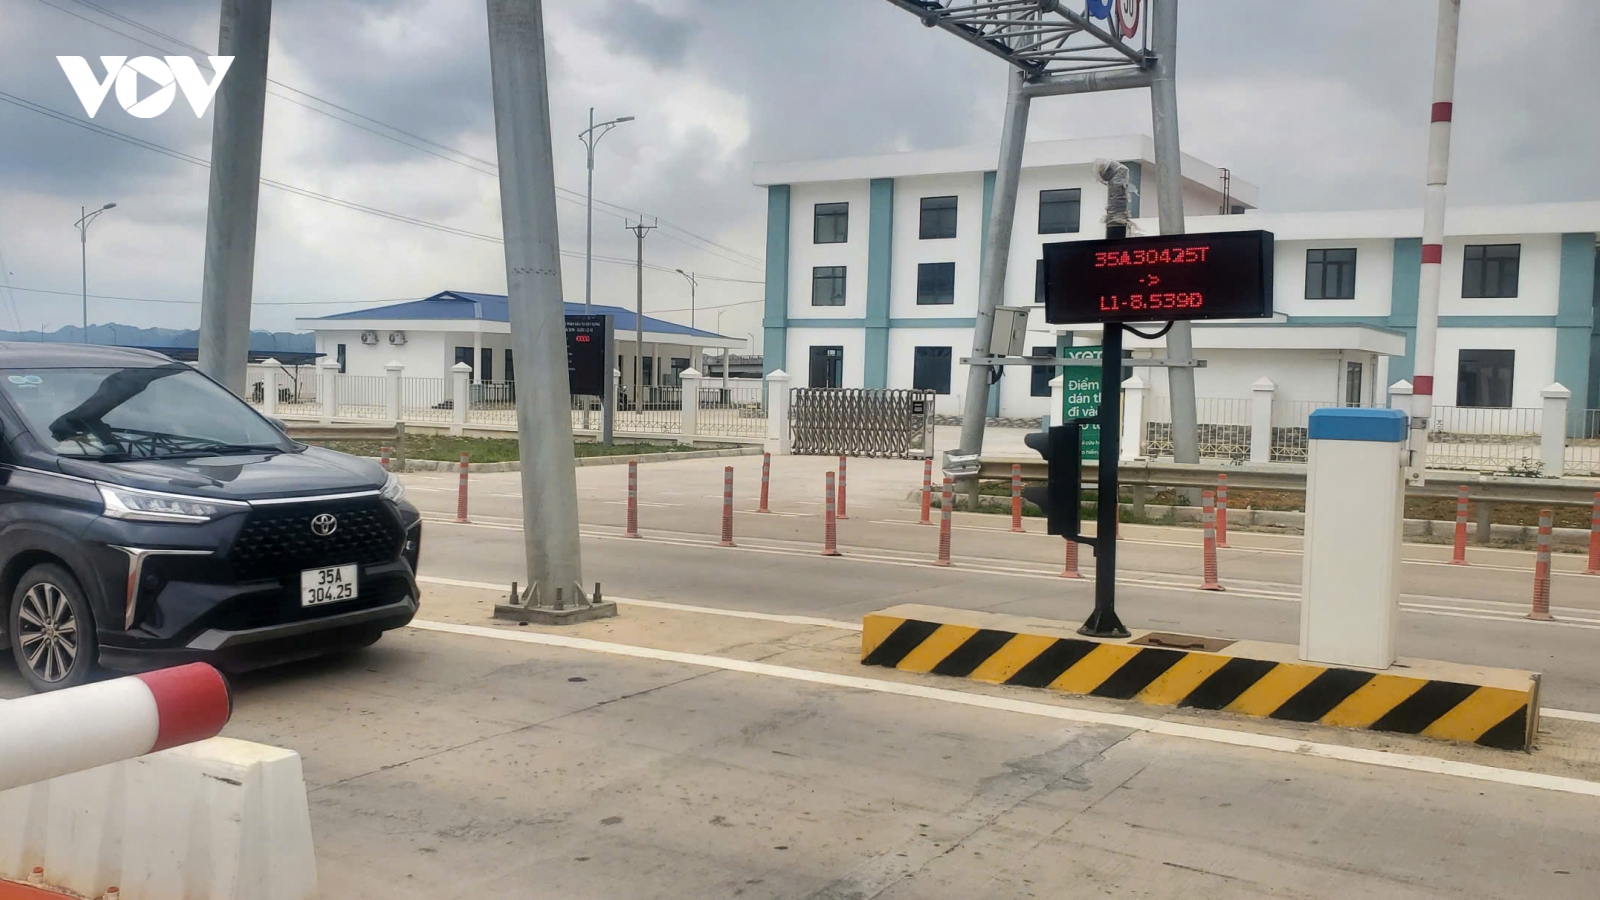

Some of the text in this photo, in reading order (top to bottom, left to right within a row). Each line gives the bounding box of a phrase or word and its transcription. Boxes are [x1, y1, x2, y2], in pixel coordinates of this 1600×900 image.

[1095, 247, 1209, 267] 35A30425T
[1068, 377, 1099, 391] Điểm
[1068, 393, 1090, 404] dán
[1068, 406, 1098, 417] đi và
[318, 568, 342, 585] 35A
[308, 583, 352, 603] 304.25
